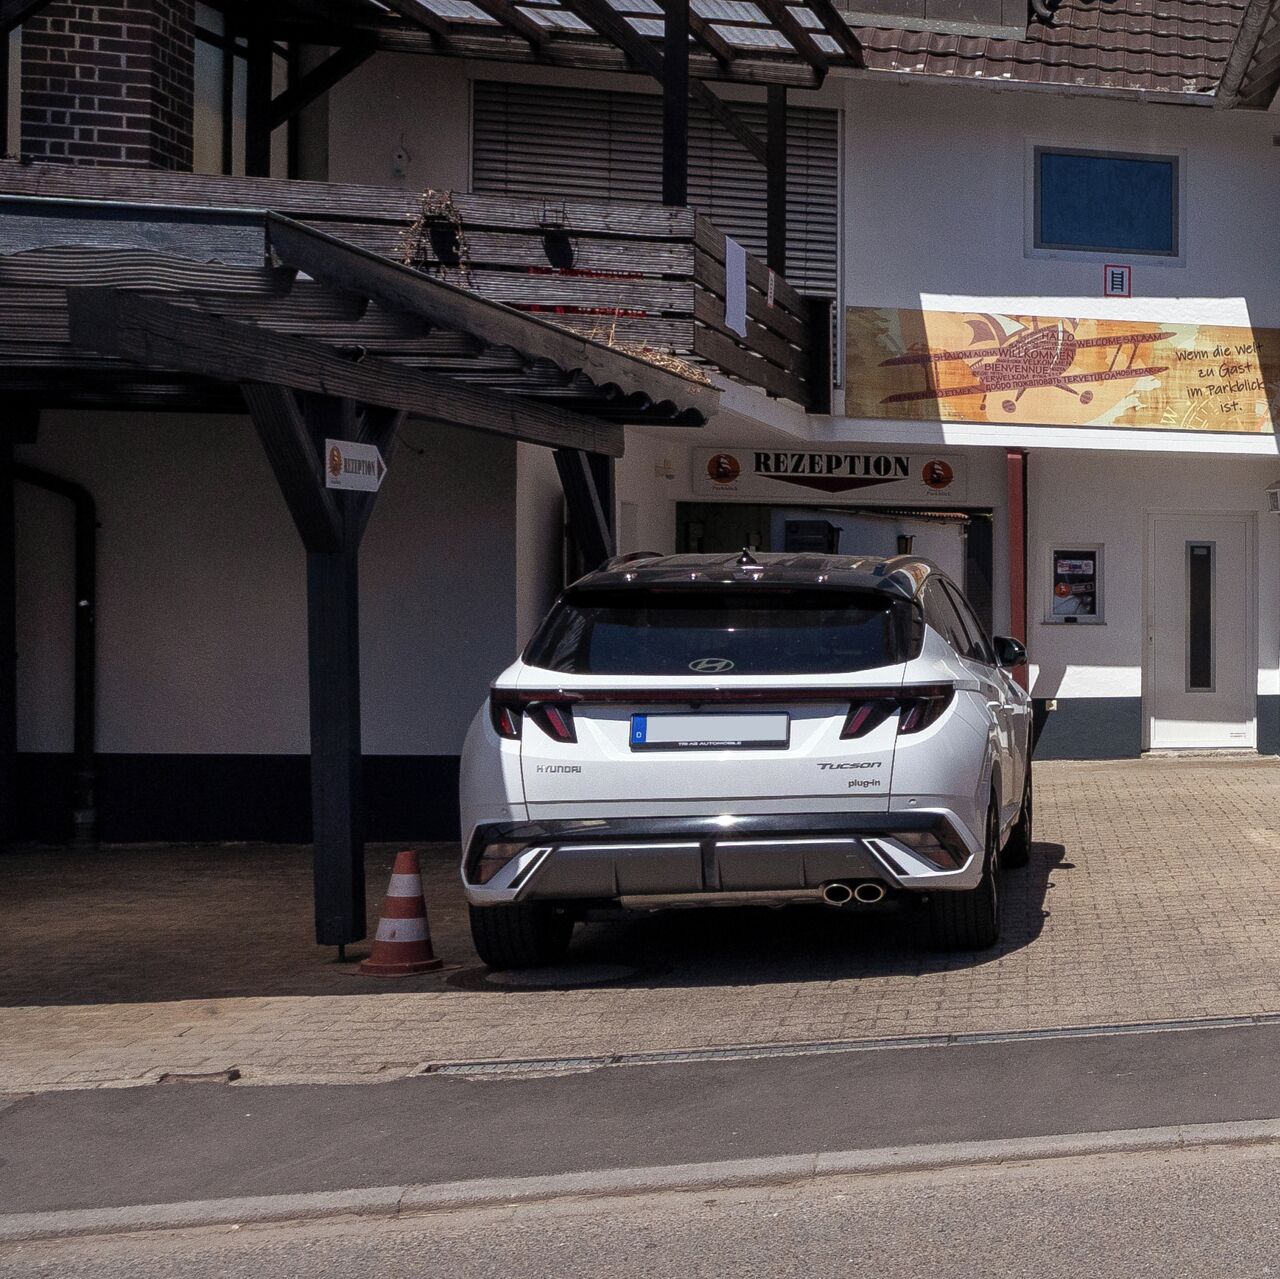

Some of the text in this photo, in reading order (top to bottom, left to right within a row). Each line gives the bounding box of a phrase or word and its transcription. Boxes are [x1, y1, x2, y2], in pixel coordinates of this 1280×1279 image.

[1076, 336, 1122, 349] WELCOME
[1123, 333, 1162, 344] SALAAM
[933, 350, 972, 360] SHALOM
[973, 350, 997, 358] ALOHA
[998, 348, 1074, 360] WILLKOMMEN
[1175, 342, 1264, 362] Wenn die Welt
[1063, 370, 1117, 384] TERVETULOA
[1198, 362, 1253, 378] zu Gast
[1186, 378, 1265, 398] im Parkblick
[753, 452, 910, 477] REZEPTION
[536, 765, 581, 773] HYUNDAI
[848, 779, 880, 788] plug-in
